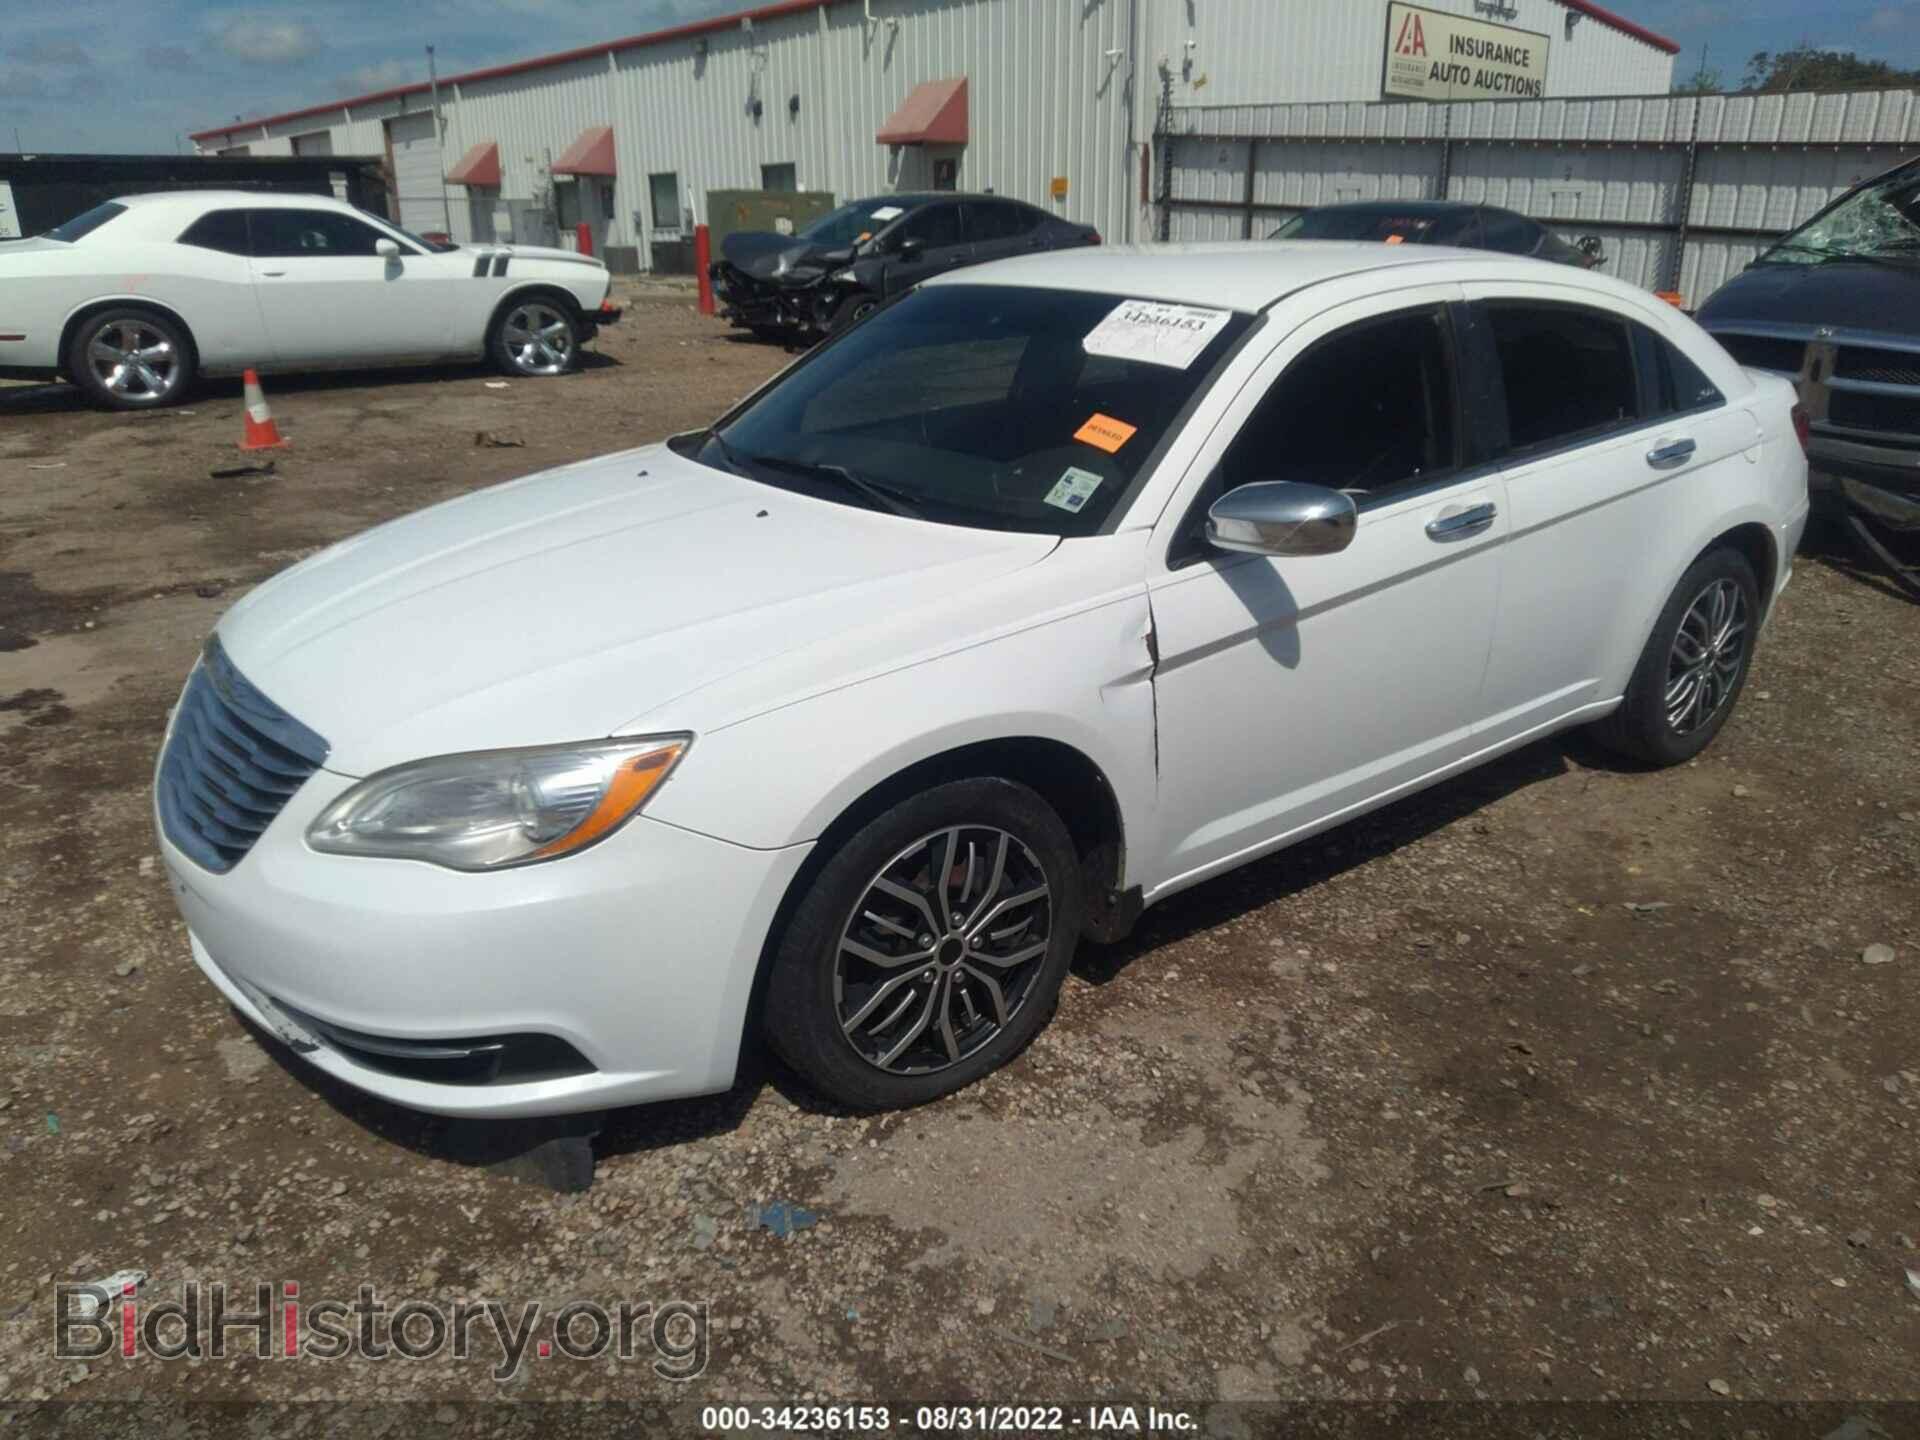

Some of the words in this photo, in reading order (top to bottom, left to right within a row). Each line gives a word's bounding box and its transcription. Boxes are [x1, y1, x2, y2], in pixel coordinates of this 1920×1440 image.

[1449, 33, 1531, 68] INSURANCE
[1428, 61, 1471, 87] AUTO
[1473, 69, 1542, 98] AUCTIONS
